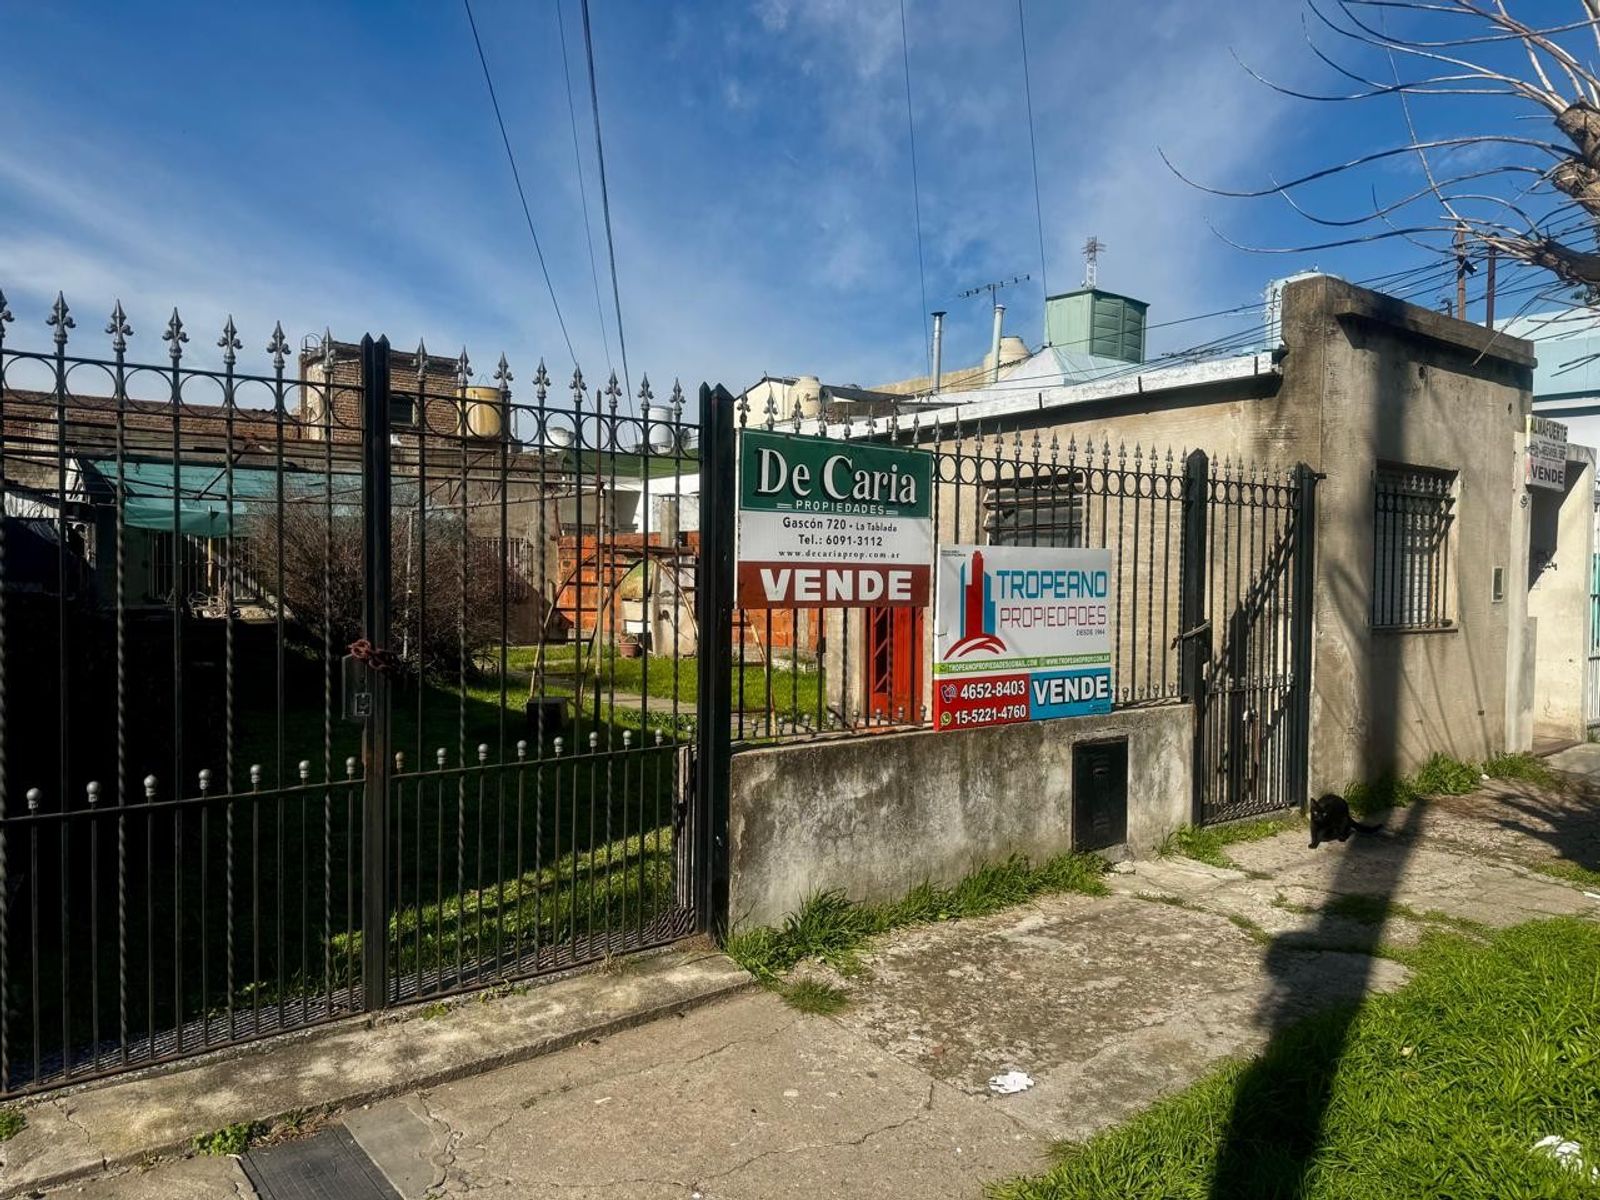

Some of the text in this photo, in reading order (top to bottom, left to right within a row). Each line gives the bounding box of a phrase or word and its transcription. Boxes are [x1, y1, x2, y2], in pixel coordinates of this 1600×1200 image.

[757, 448, 917, 504] De Caria
[1531, 464, 1564, 485] VENDE
[795, 500, 885, 515] PROPIEDADES
[782, 517, 823, 530] Gascón
[826, 518, 847, 530] 720
[867, 522, 897, 532] Tablada
[826, 535, 883, 546] 6091-3112
[778, 550, 901, 560] www.decariaprop.com.ar
[760, 568, 913, 602] VENDE
[996, 570, 1107, 599] TROPEANO
[1000, 605, 1107, 628] PROPIEDADES
[960, 680, 1026, 700] 4652-8403
[1032, 675, 1109, 705] VENDE
[955, 705, 1026, 725] 15-5221-4760
